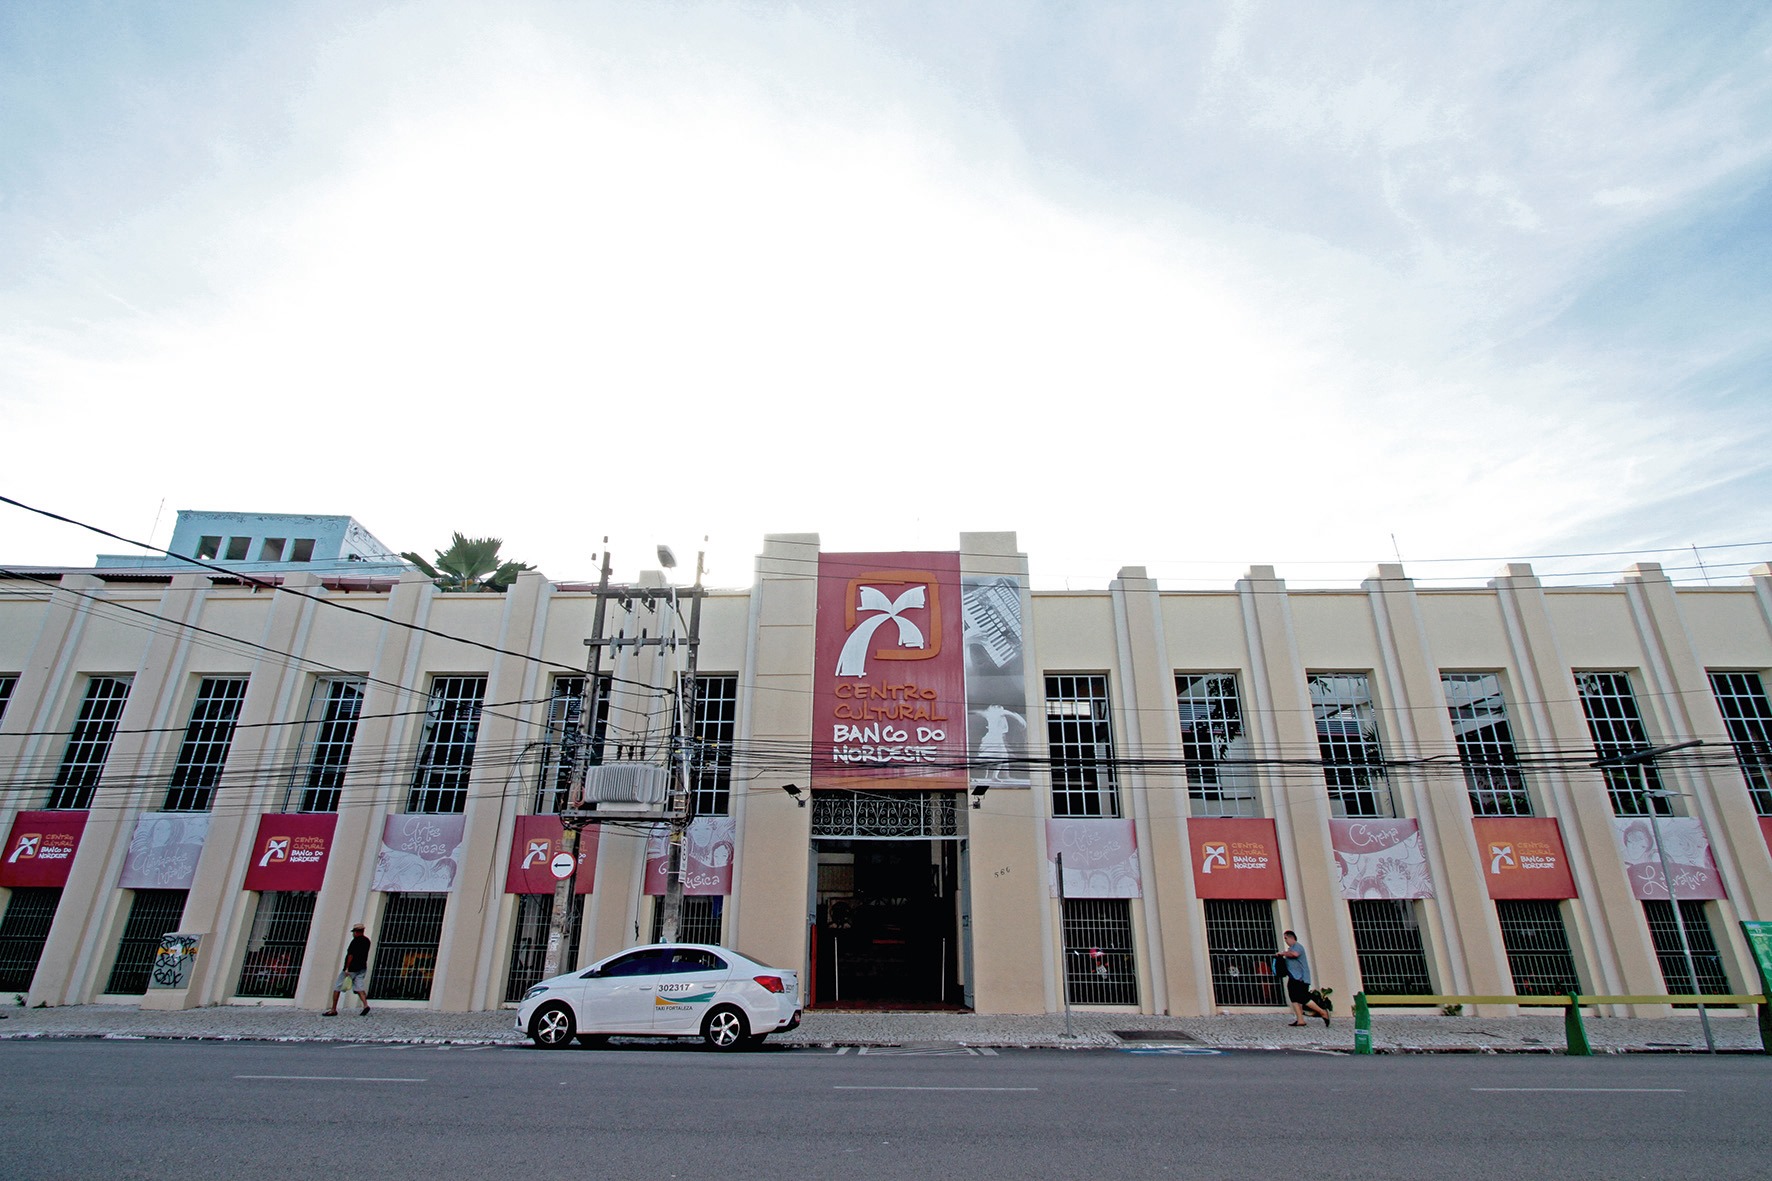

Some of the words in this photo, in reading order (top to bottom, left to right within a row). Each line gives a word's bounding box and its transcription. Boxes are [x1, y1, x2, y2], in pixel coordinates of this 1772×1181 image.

[835, 680, 937, 700] CENTRO
[834, 700, 948, 721] CULTURAL
[833, 722, 908, 743] BANCO
[916, 726, 946, 743] DO
[833, 744, 937, 764] NORDESTE
[1349, 824, 1399, 846] Cinema
[1638, 865, 1708, 895] Liratura
